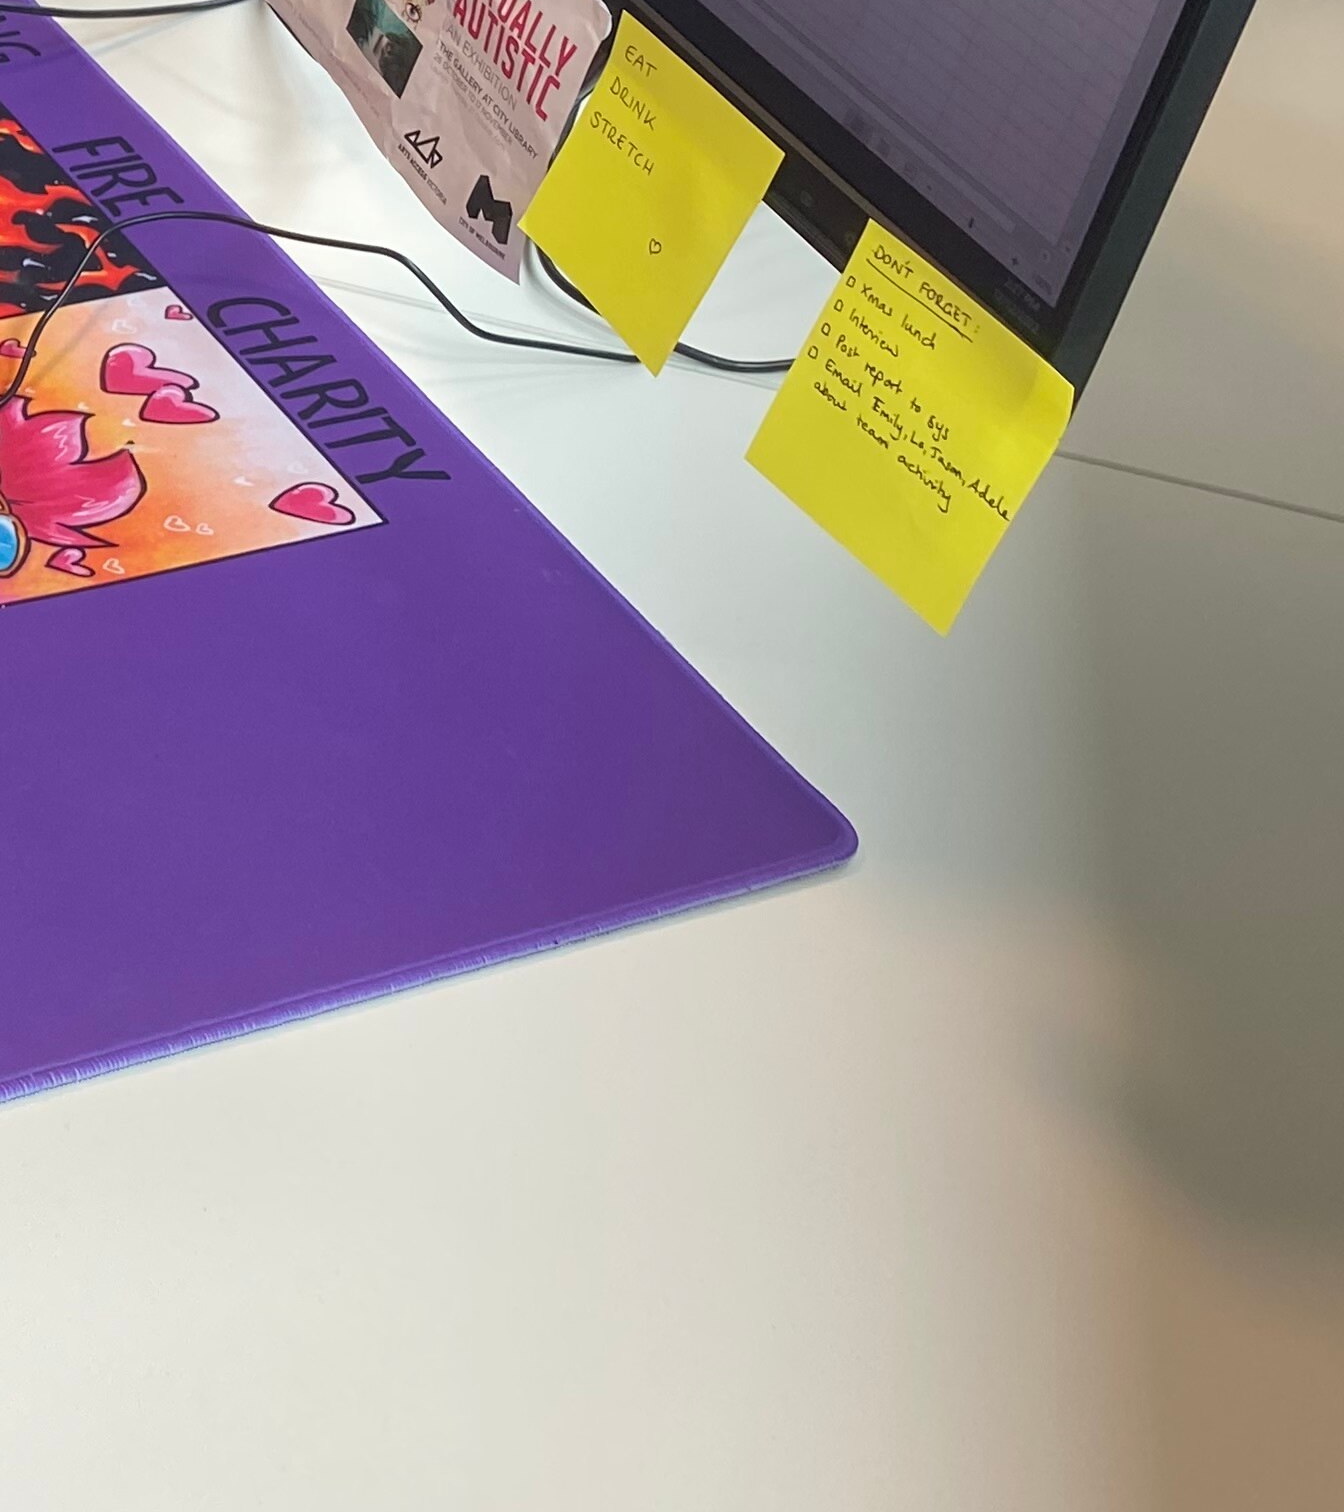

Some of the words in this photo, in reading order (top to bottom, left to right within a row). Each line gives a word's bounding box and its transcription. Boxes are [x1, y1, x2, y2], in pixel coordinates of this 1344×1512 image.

[445, 25, 462, 47] AN
[462, 39, 518, 111] EXHIBITION
[624, 45, 658, 78] EAT
[439, 40, 454, 62] THE
[453, 57, 483, 95] GALLERY
[481, 93, 494, 107] AT
[493, 104, 509, 125] CITY
[508, 123, 539, 160] LIBRARY
[610, 76, 656, 131] DRINK
[589, 111, 655, 176] STRETCH
[53, 136, 184, 220] FIRE
[872, 244, 914, 279] DON'T
[849, 308, 900, 358] Interview
[860, 283, 893, 317] Xmas
[901, 313, 937, 351] lunch
[208, 296, 452, 488] CHARITY
[864, 360, 902, 395] report
[910, 397, 922, 414] to
[813, 381, 848, 412] about
[855, 412, 889, 449] team
[897, 454, 952, 514] activity
[825, 358, 862, 396] Email
[968, 479, 1011, 522] Adele
